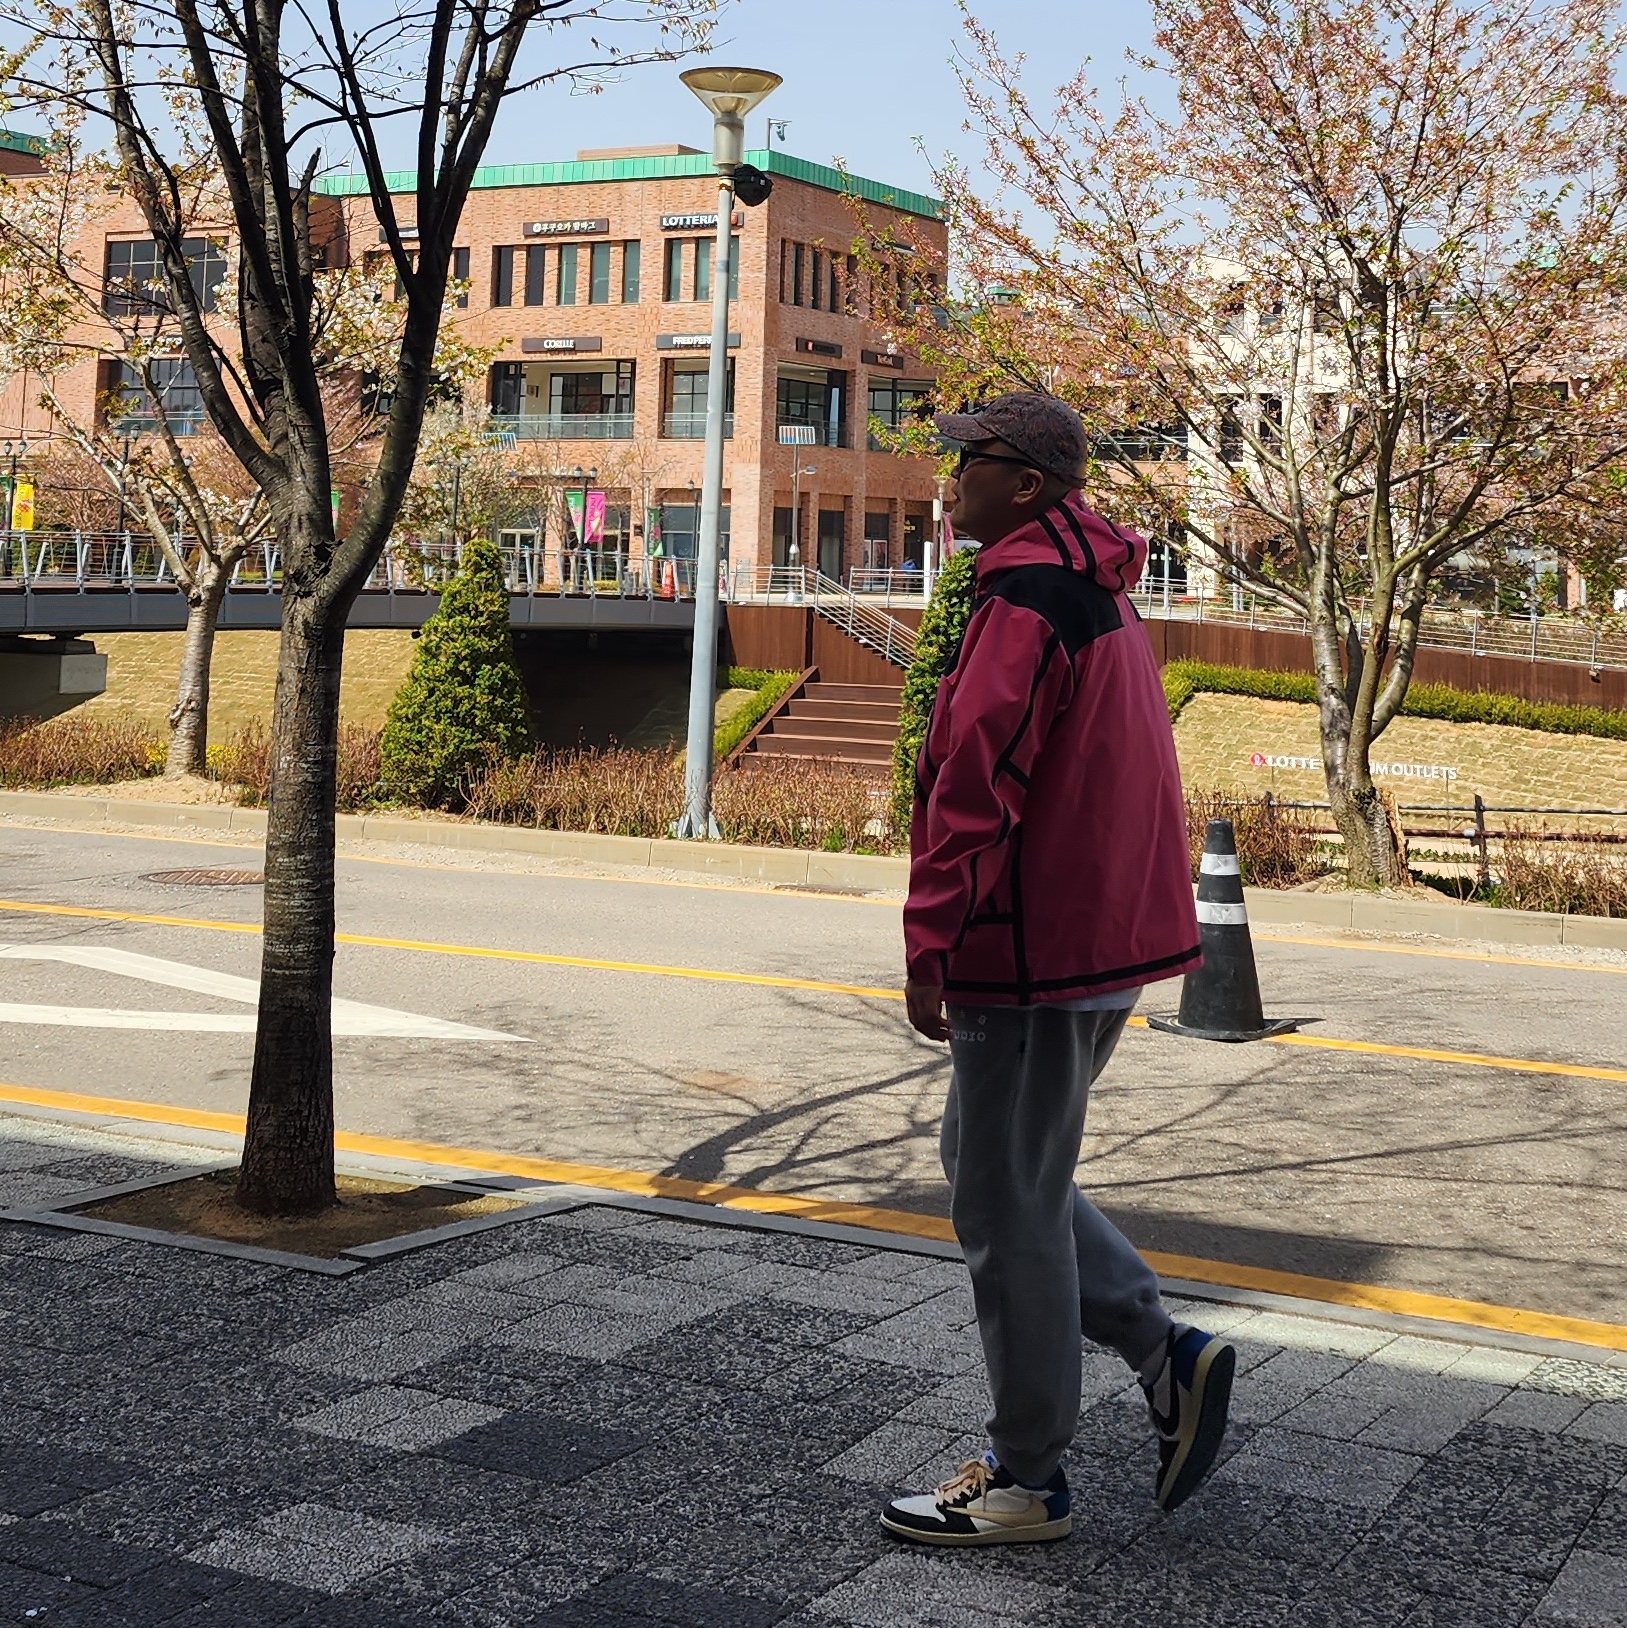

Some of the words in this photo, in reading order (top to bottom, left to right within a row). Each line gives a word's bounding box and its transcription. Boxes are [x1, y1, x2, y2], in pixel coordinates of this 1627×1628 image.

[662, 214, 718, 226] LOTTERIA
[1267, 755, 1320, 770] LOTTE
[1391, 763, 1457, 780] OUTLETS
